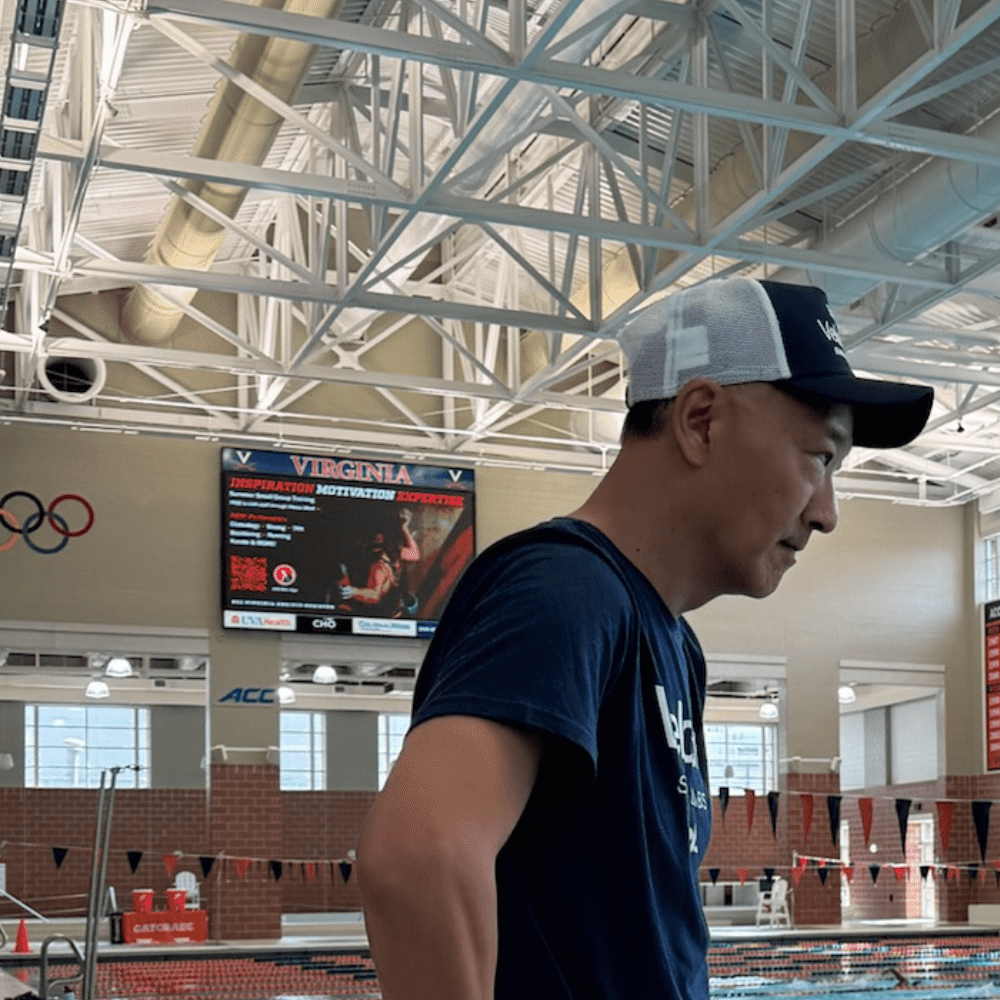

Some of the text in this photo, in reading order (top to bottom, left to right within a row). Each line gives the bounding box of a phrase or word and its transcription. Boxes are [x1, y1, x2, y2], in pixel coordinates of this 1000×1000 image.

[290, 455, 413, 486] VIRGINIA
[229, 477, 315, 494] INSPIRATION
[316, 484, 396, 500] MOTIVATION
[217, 687, 275, 703] ACC
